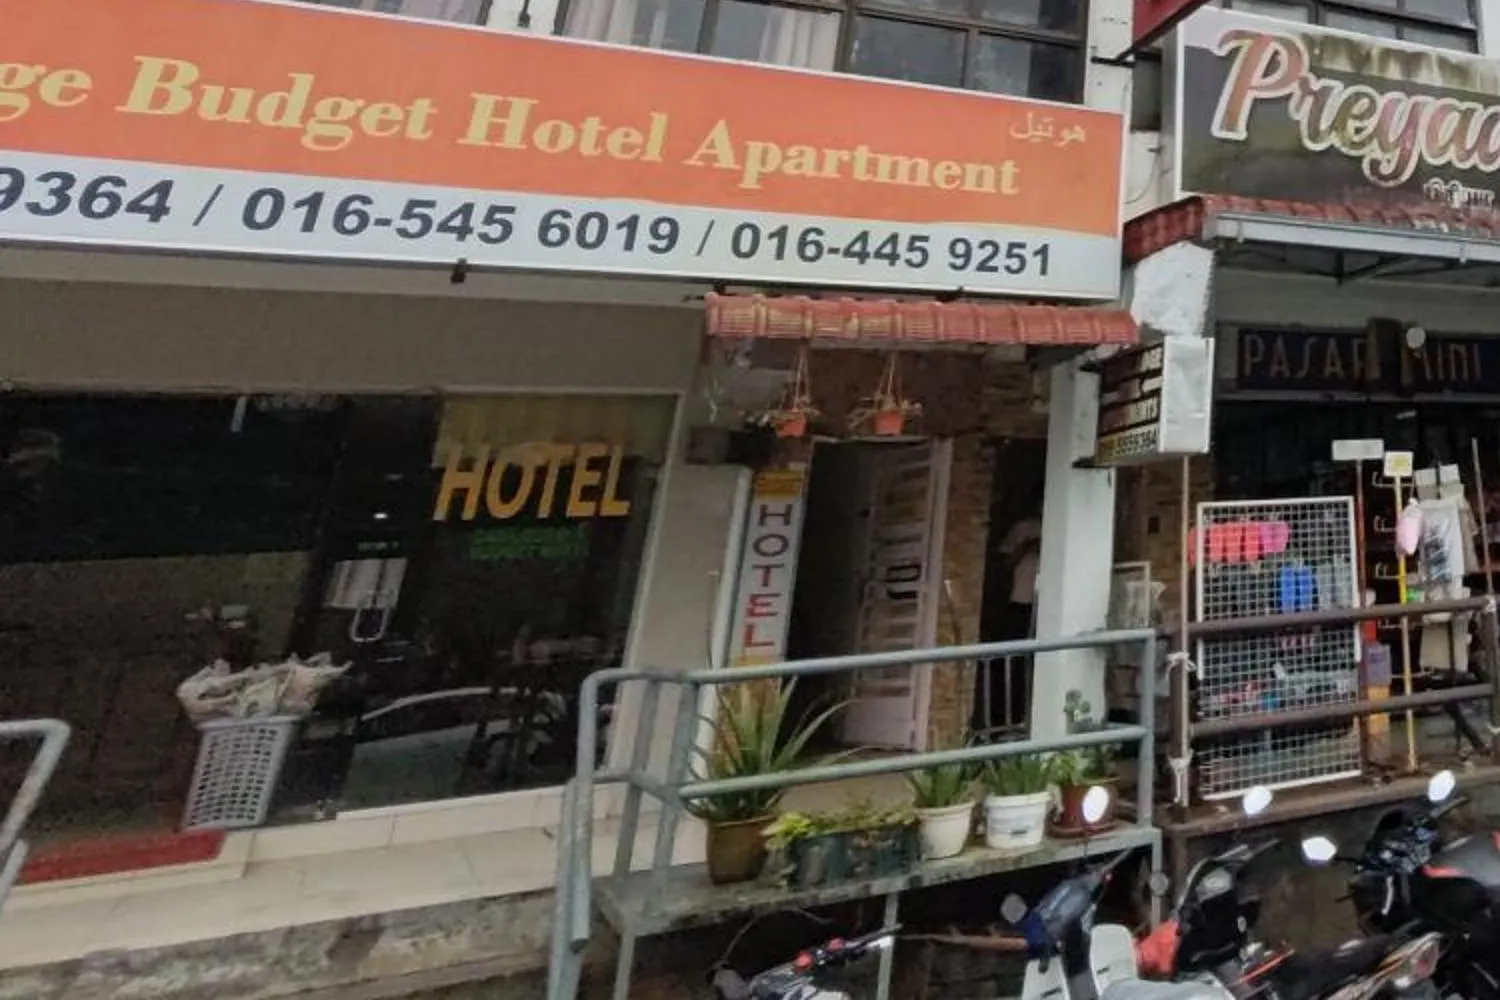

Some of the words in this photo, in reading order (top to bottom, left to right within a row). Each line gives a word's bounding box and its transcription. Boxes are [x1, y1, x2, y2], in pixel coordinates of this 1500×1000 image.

[115, 55, 438, 152] Budget
[456, 91, 668, 162] Hotel
[683, 118, 1020, 196] Apartment
[241, 186, 517, 245] 016-545
[537, 208, 680, 255] 6019
[730, 221, 931, 270] 016-445
[947, 237, 1052, 278] 9251
[433, 440, 631, 522] HOTEL
[741, 503, 793, 649] HOTEL
